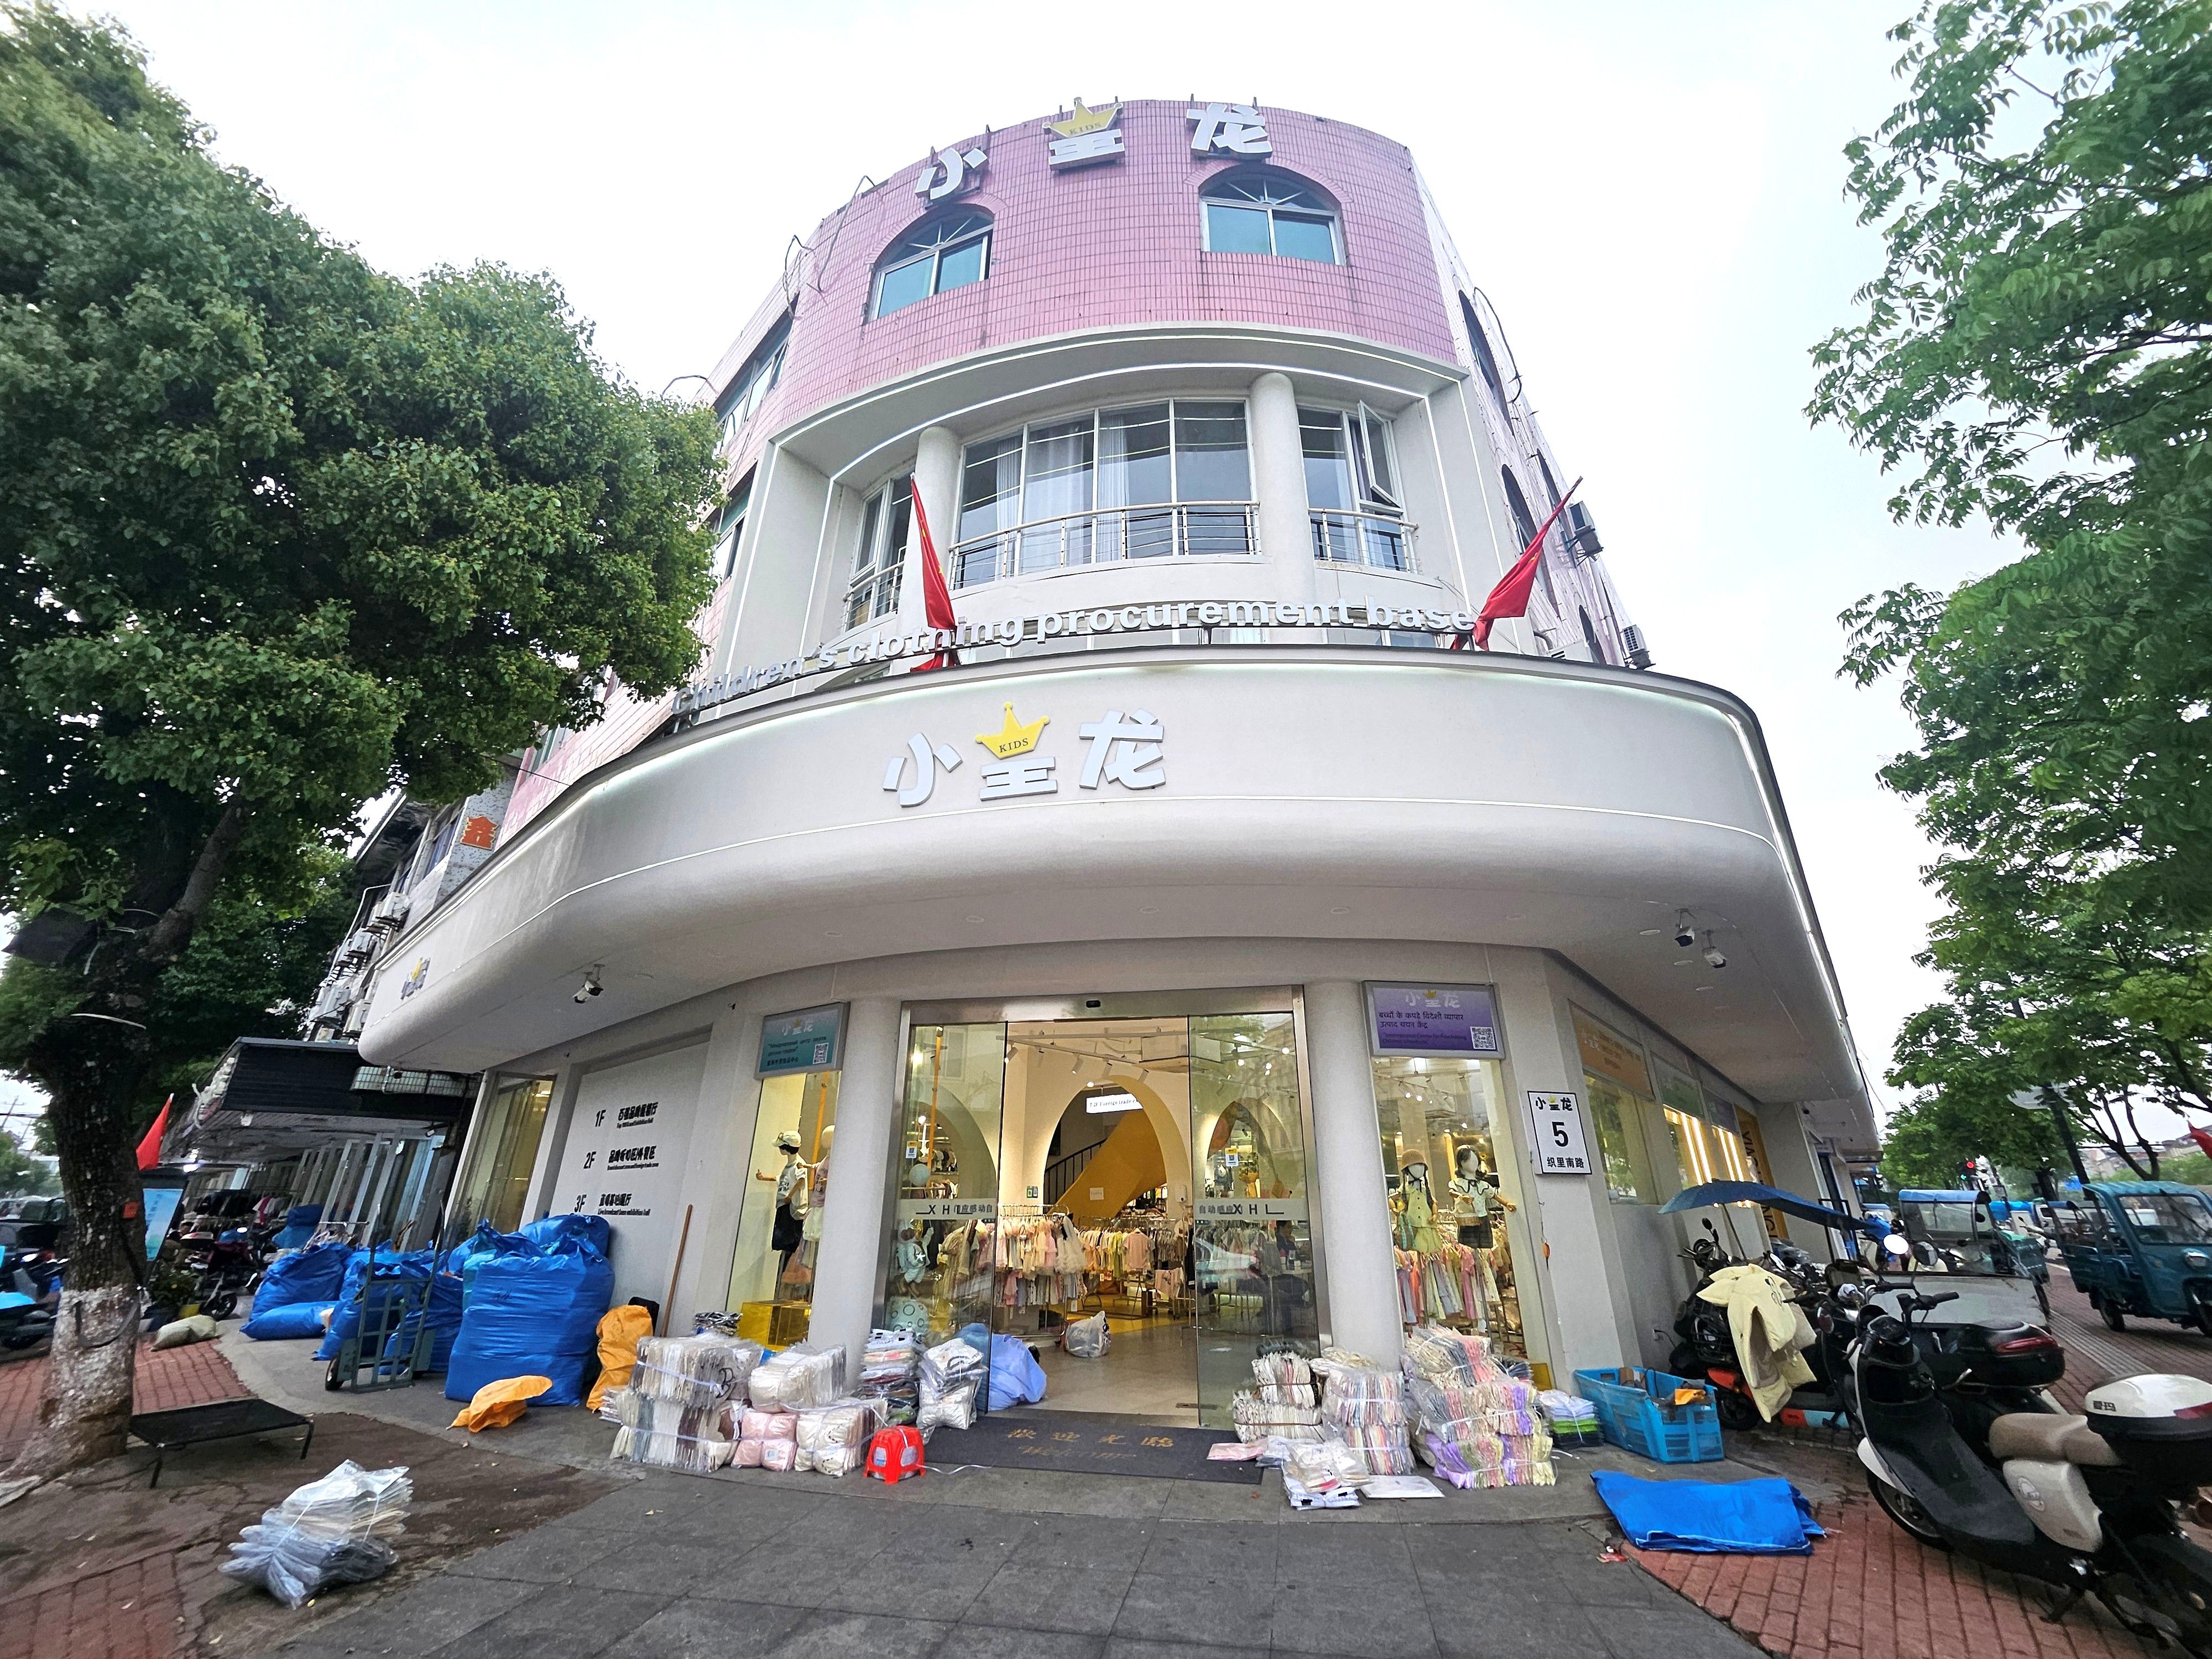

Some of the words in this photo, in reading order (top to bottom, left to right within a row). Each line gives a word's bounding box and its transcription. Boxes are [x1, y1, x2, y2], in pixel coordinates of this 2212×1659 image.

[1069, 122, 1102, 136] KIDS
[848, 615, 1025, 665] clothing
[1037, 598, 1354, 643] procurement
[1365, 594, 1475, 632] base
[999, 737, 1029, 754] KIDS
[595, 1109, 607, 1128] 1F
[1552, 1121, 1569, 1147] 5
[583, 1151, 597, 1169] 2F
[1547, 1157, 1584, 1168] 织里南路
[575, 1194, 587, 1213] 3F
